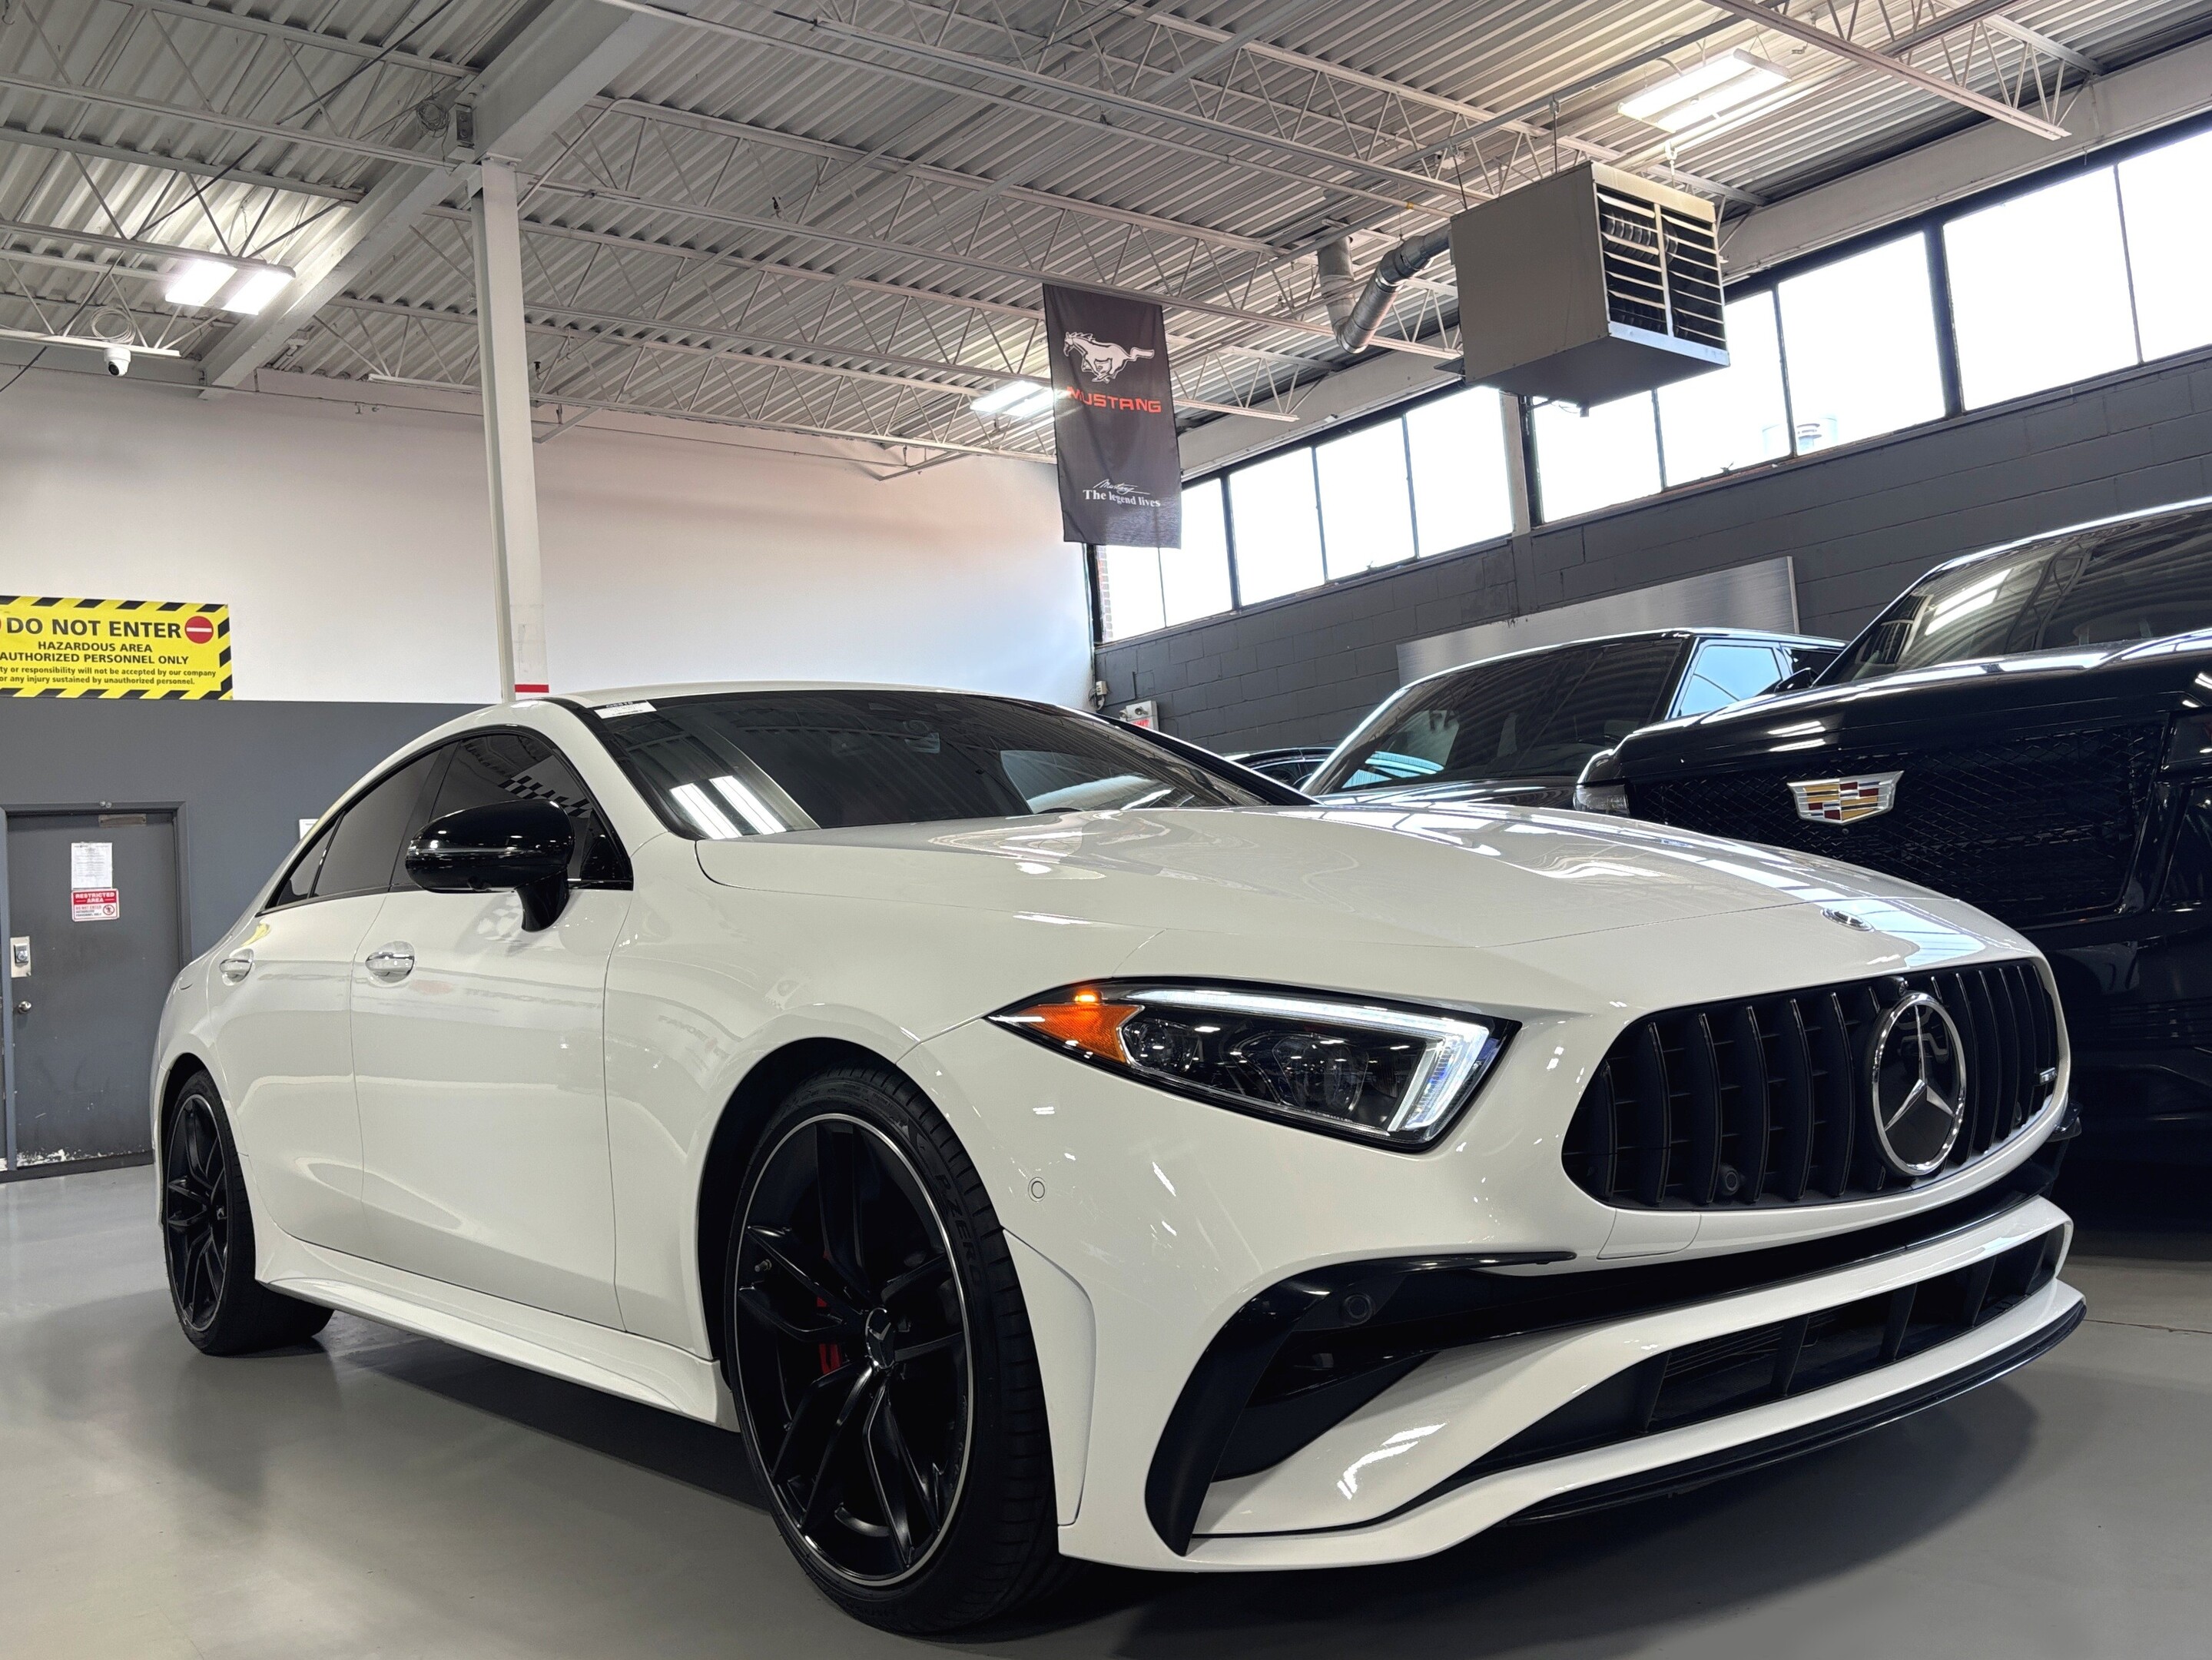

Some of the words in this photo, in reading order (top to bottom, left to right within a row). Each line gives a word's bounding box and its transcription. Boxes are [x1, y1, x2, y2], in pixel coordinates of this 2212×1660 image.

[1066, 386, 1162, 413] MUSTANG
[1083, 489, 1106, 500] The
[1109, 491, 1136, 505] legend
[1138, 496, 1161, 507] lives
[6, 617, 43, 635] DO
[52, 619, 101, 636] NOT
[109, 621, 181, 639] ENTER
[38, 641, 116, 652] HAZARDOUS
[120, 643, 153, 652] AREA
[0, 652, 80, 662] AUTHORIZED
[84, 654, 155, 664] PERSONNEL
[158, 656, 189, 665] ONLY
[22, 666, 75, 676] responsibility
[27, 676, 50, 684] injury
[92, 676, 101, 685] by
